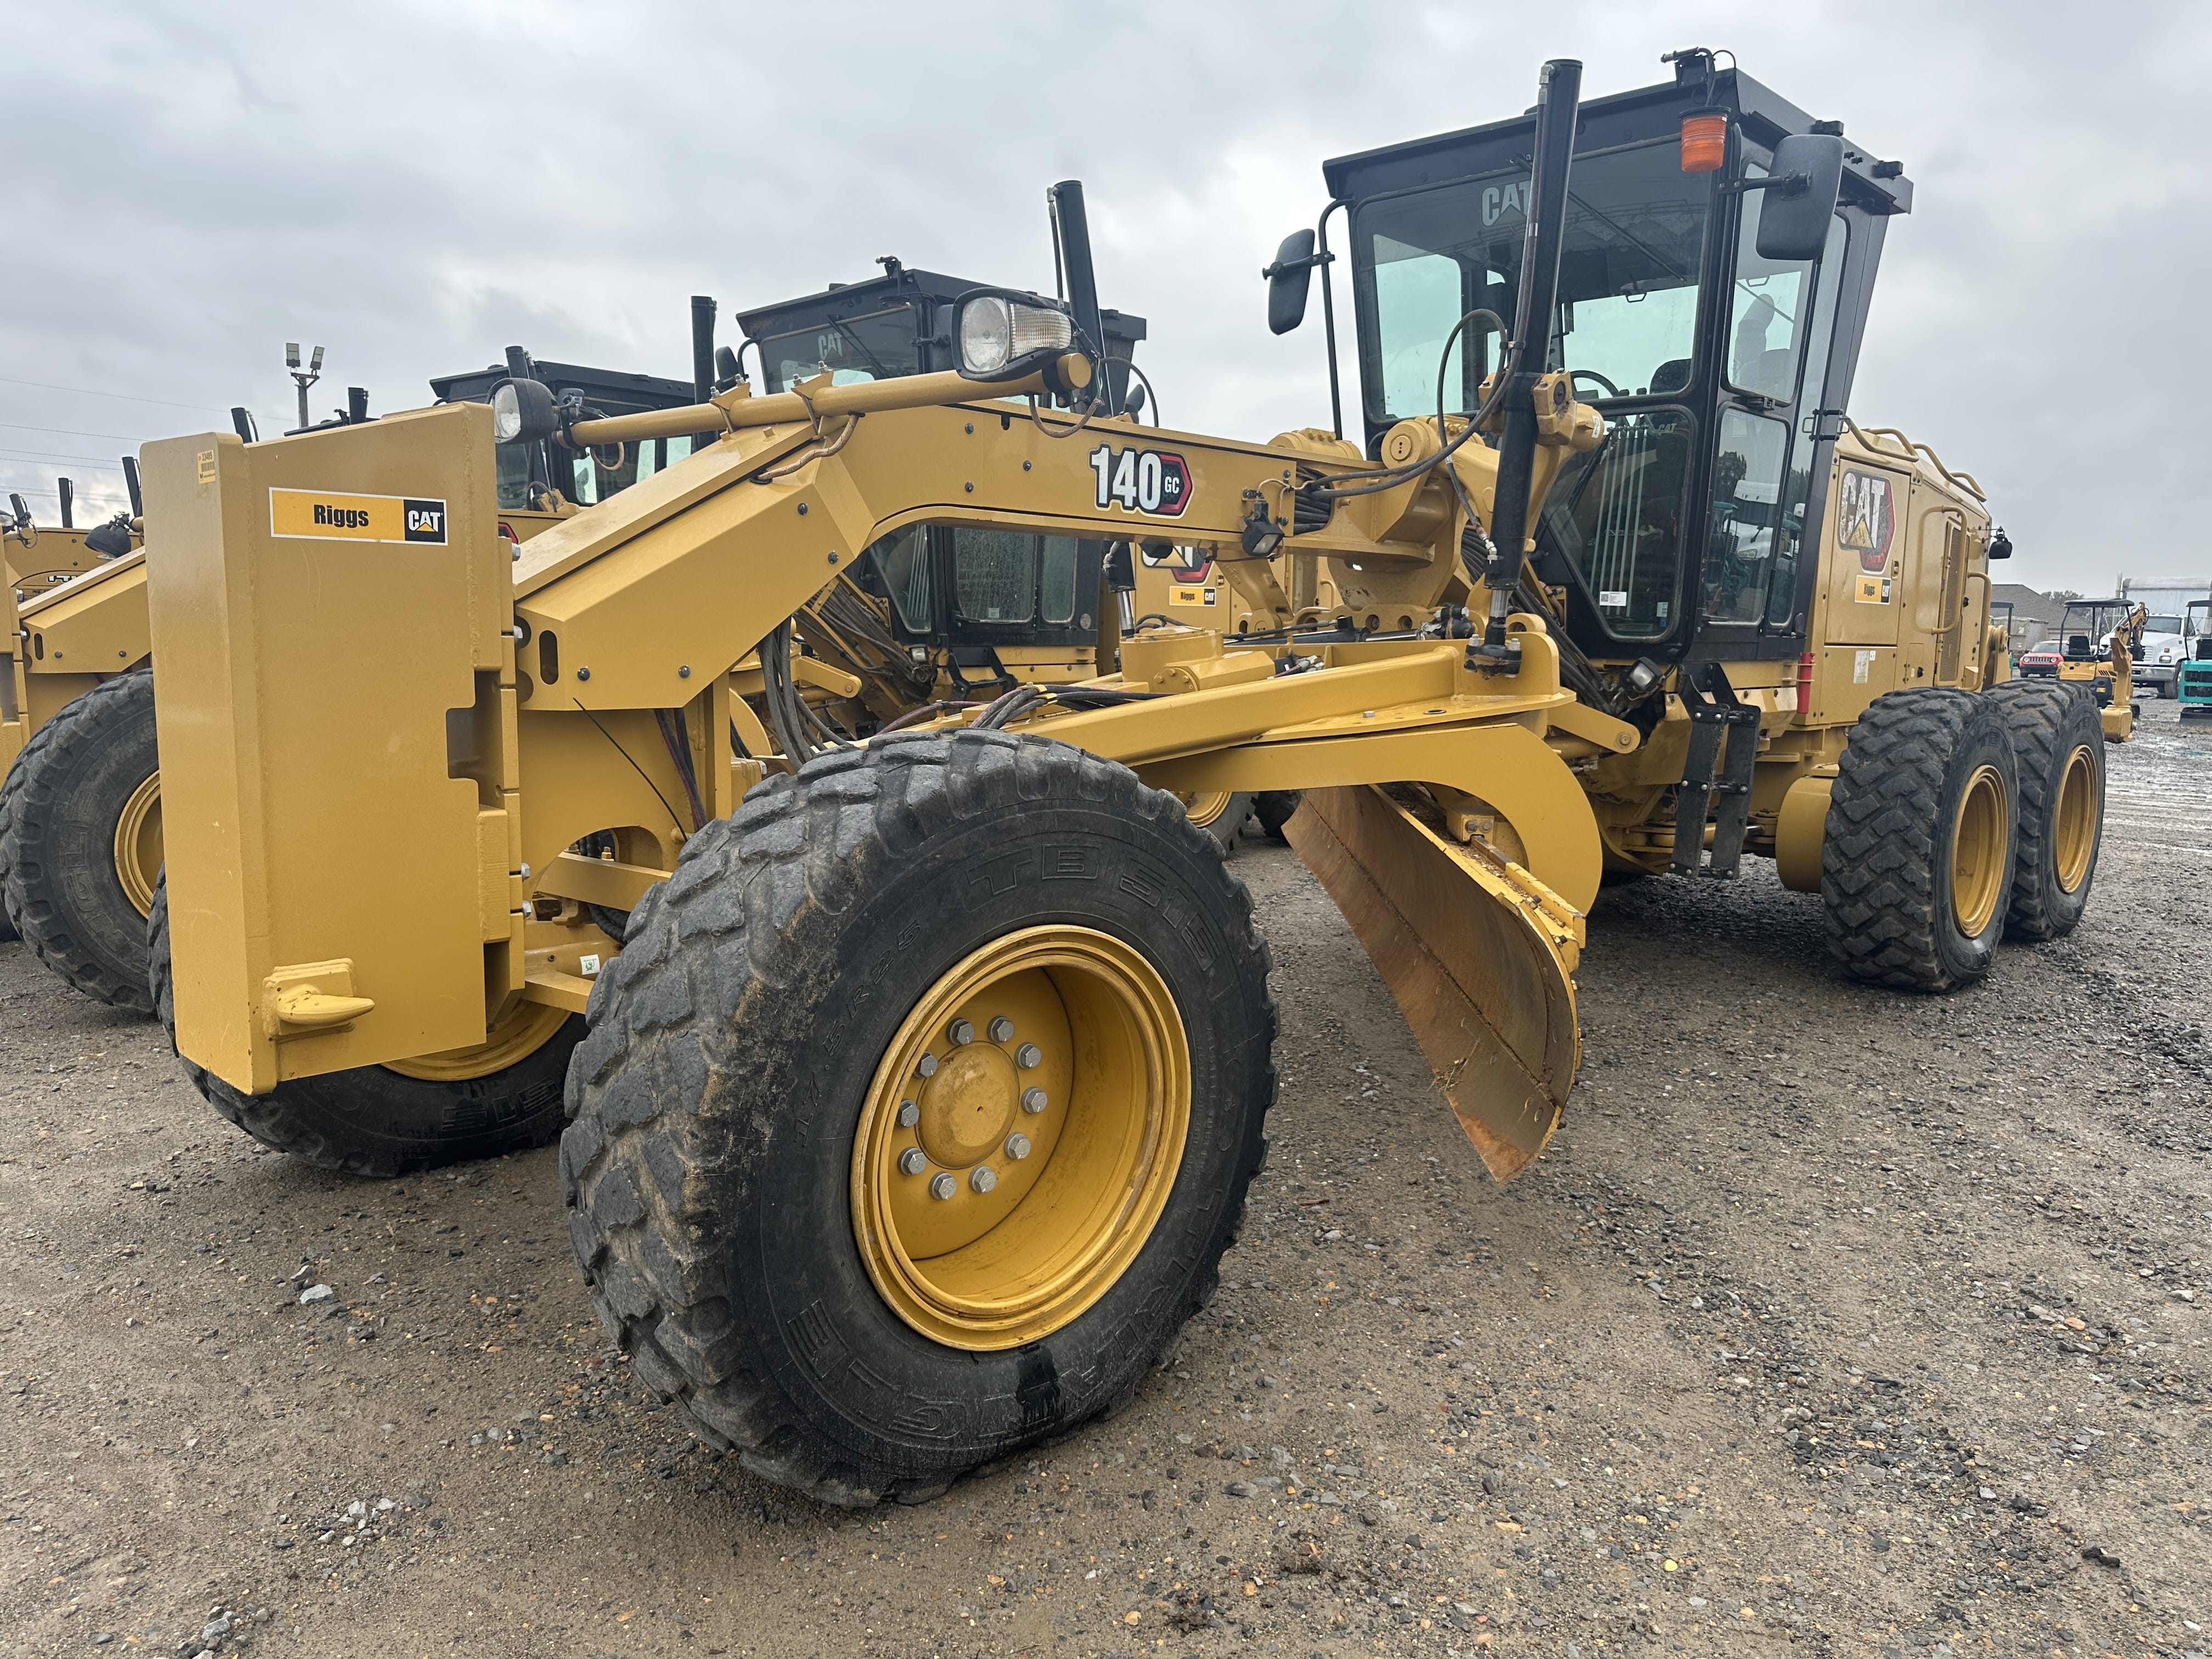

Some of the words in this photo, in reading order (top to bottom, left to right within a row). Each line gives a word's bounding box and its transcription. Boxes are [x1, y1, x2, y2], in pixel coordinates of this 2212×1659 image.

[1482, 180, 1532, 227] CAT
[818, 332, 843, 361] CAT
[1092, 447, 1161, 510] 140
[1165, 476, 1180, 494] GC
[314, 504, 369, 528] Riggs
[408, 510, 441, 532] CAT
[1839, 472, 1886, 549] CAT
[1181, 591, 1195, 601] Riggs
[1205, 592, 1214, 601] CAT
[1863, 583, 1875, 596] Riggs
[1882, 585, 1890, 597] CAT
